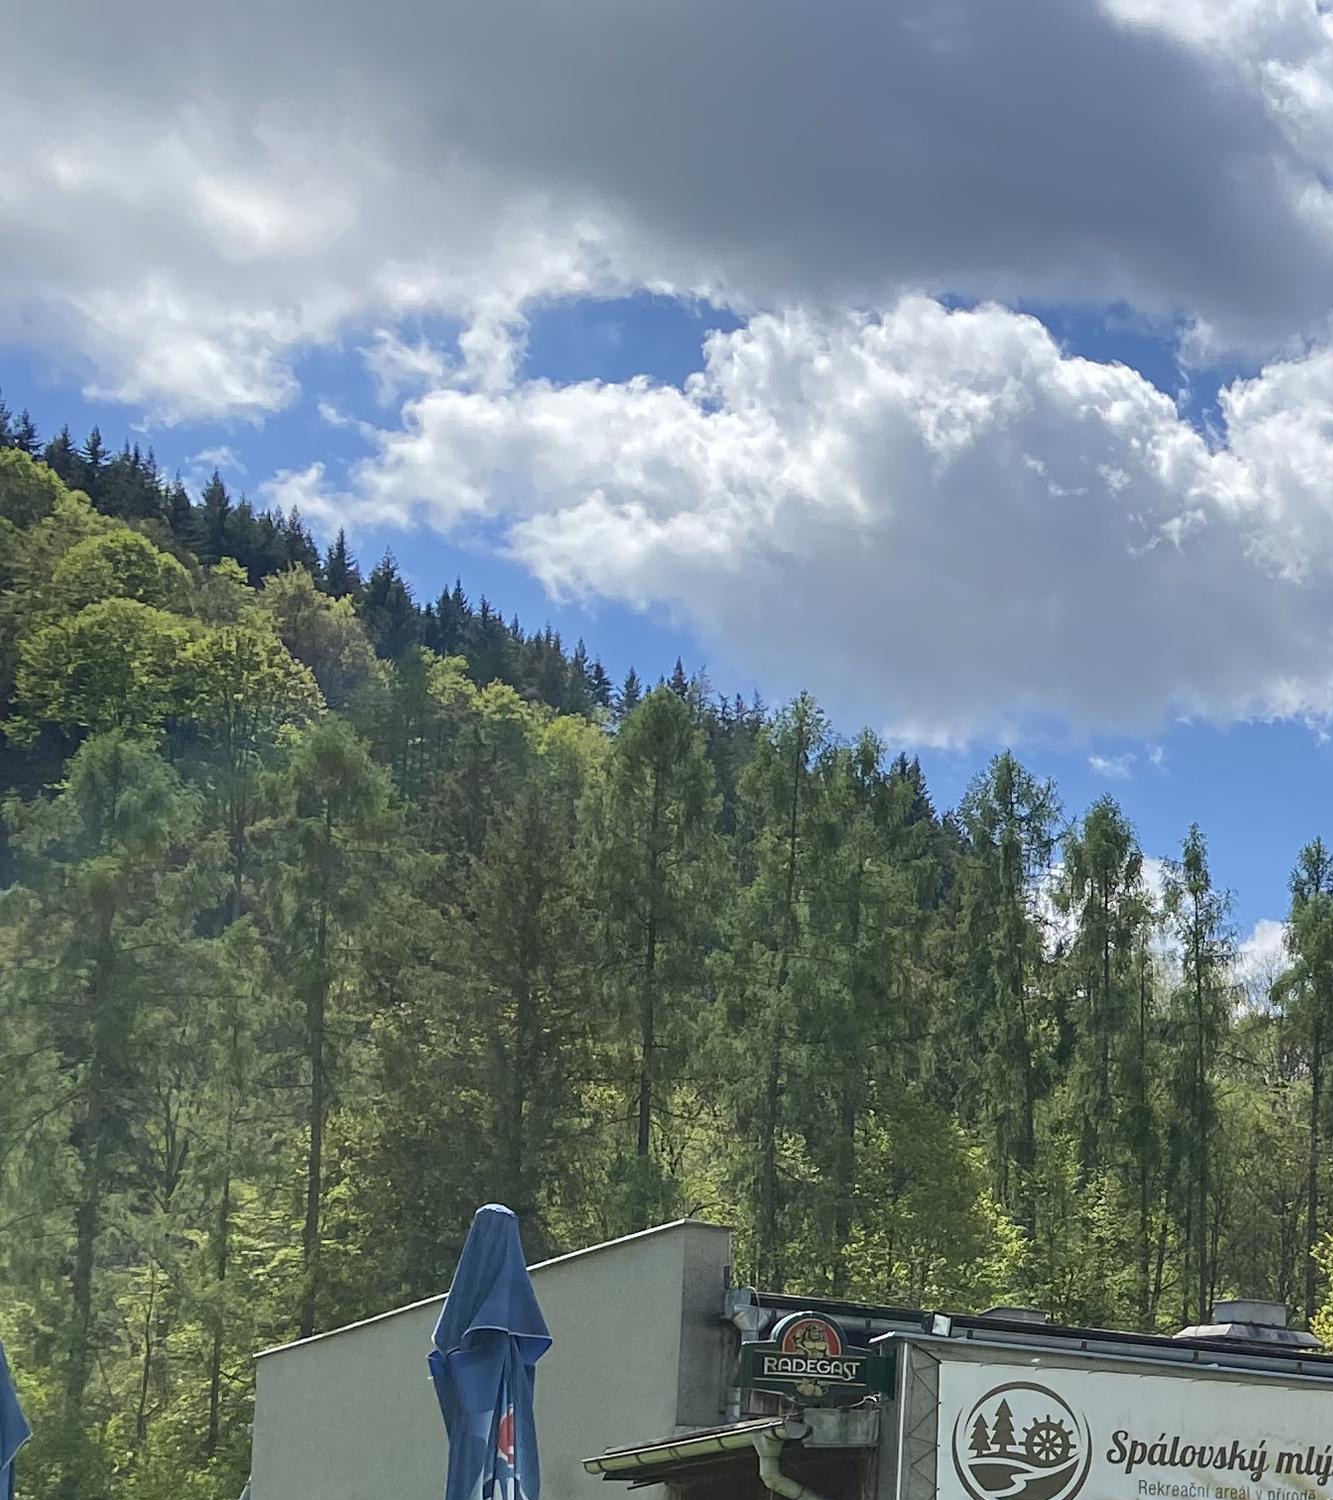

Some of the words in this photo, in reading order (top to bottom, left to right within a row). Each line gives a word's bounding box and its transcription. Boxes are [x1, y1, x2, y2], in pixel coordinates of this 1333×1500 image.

[763, 1356, 861, 1381] RADEGAST
[1106, 1429, 1269, 1483] Spálovský
[1137, 1479, 1210, 1498] Rekreační
[1214, 1483, 1251, 1500] areál
[1255, 1489, 1263, 1500] v
